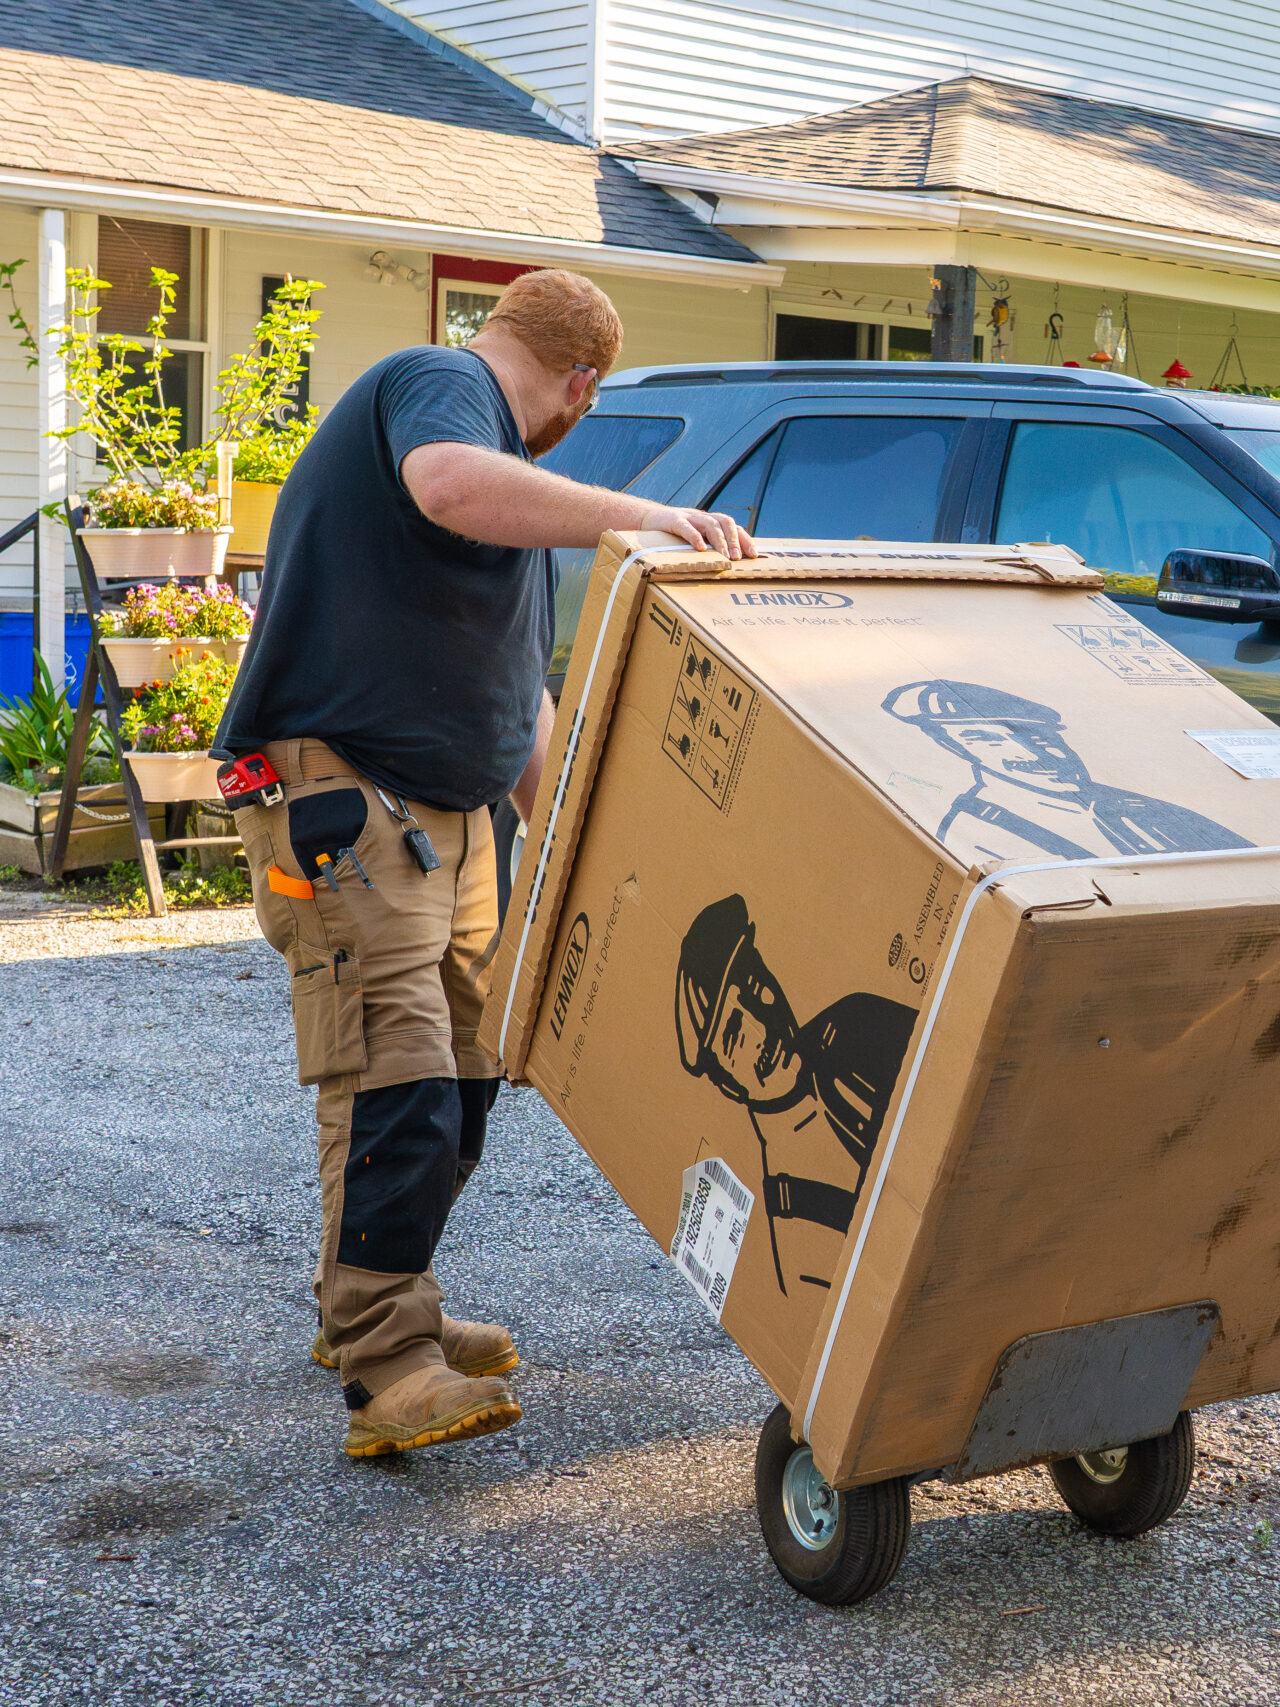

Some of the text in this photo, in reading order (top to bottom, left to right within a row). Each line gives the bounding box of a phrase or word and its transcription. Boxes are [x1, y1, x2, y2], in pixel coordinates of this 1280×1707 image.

[730, 593, 831, 606] LENNOX
[711, 617, 735, 627] Air
[738, 617, 754, 626] is
[793, 616, 840, 626] Make
[840, 617, 858, 626] it
[674, 626, 682, 646] UP
[707, 665, 718, 692] CLAMP
[698, 706, 706, 727] FORK
[727, 730, 739, 764] FRAGILE
[717, 774, 726, 797] HAND
[913, 862, 945, 945] ASSEMBLED
[933, 903, 945, 921] IN
[593, 961, 604, 978] it
[550, 932, 584, 1042] LENNOX
[580, 981, 599, 1027] Make
[571, 1034, 587, 1062] life.
[568, 1063, 578, 1080] is
[560, 1079, 572, 1108] Air
[708, 1271, 728, 1312] 28X09
